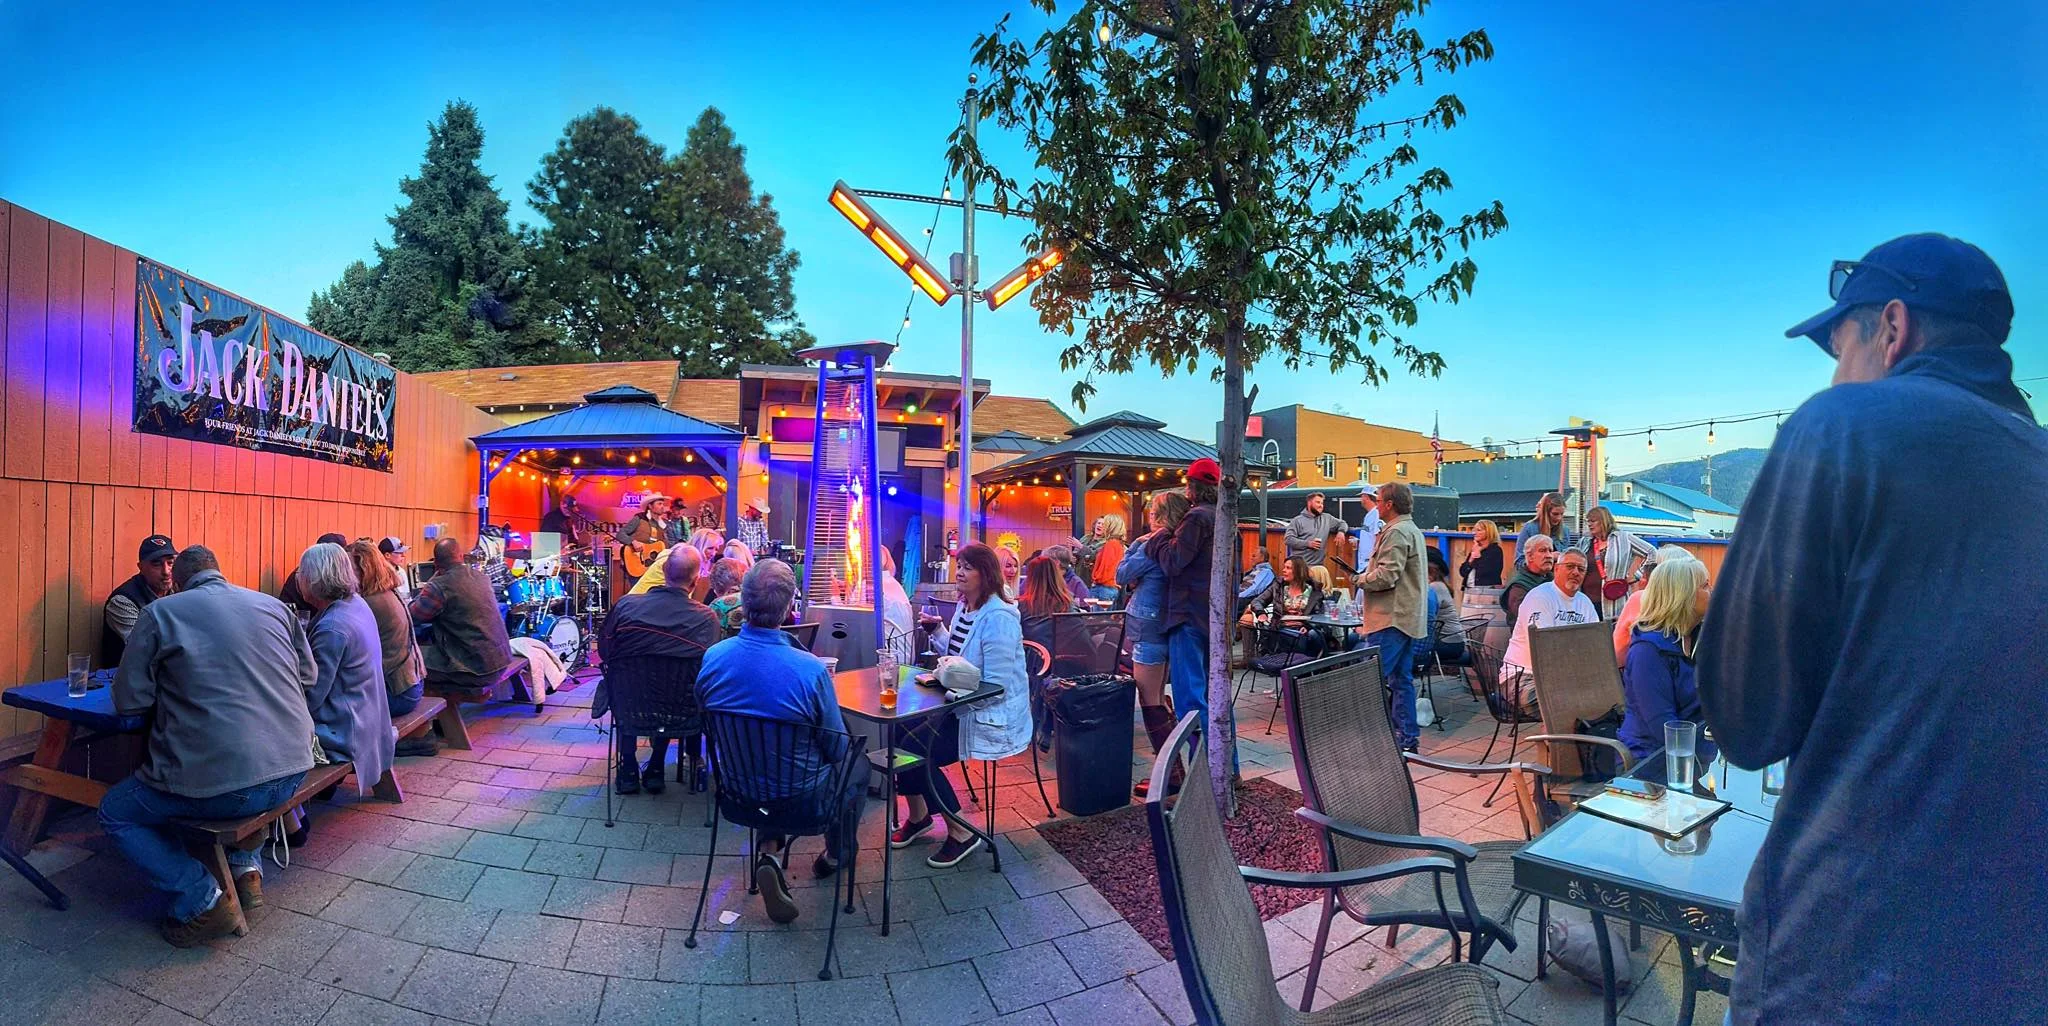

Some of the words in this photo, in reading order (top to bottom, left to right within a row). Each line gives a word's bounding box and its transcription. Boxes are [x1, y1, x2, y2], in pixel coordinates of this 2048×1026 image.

[158, 301, 269, 411] JACK
[204, 417, 221, 429] YOUR
[246, 427, 253, 435] AT
[253, 428, 269, 437] JACK
[321, 441, 329, 449] TO
